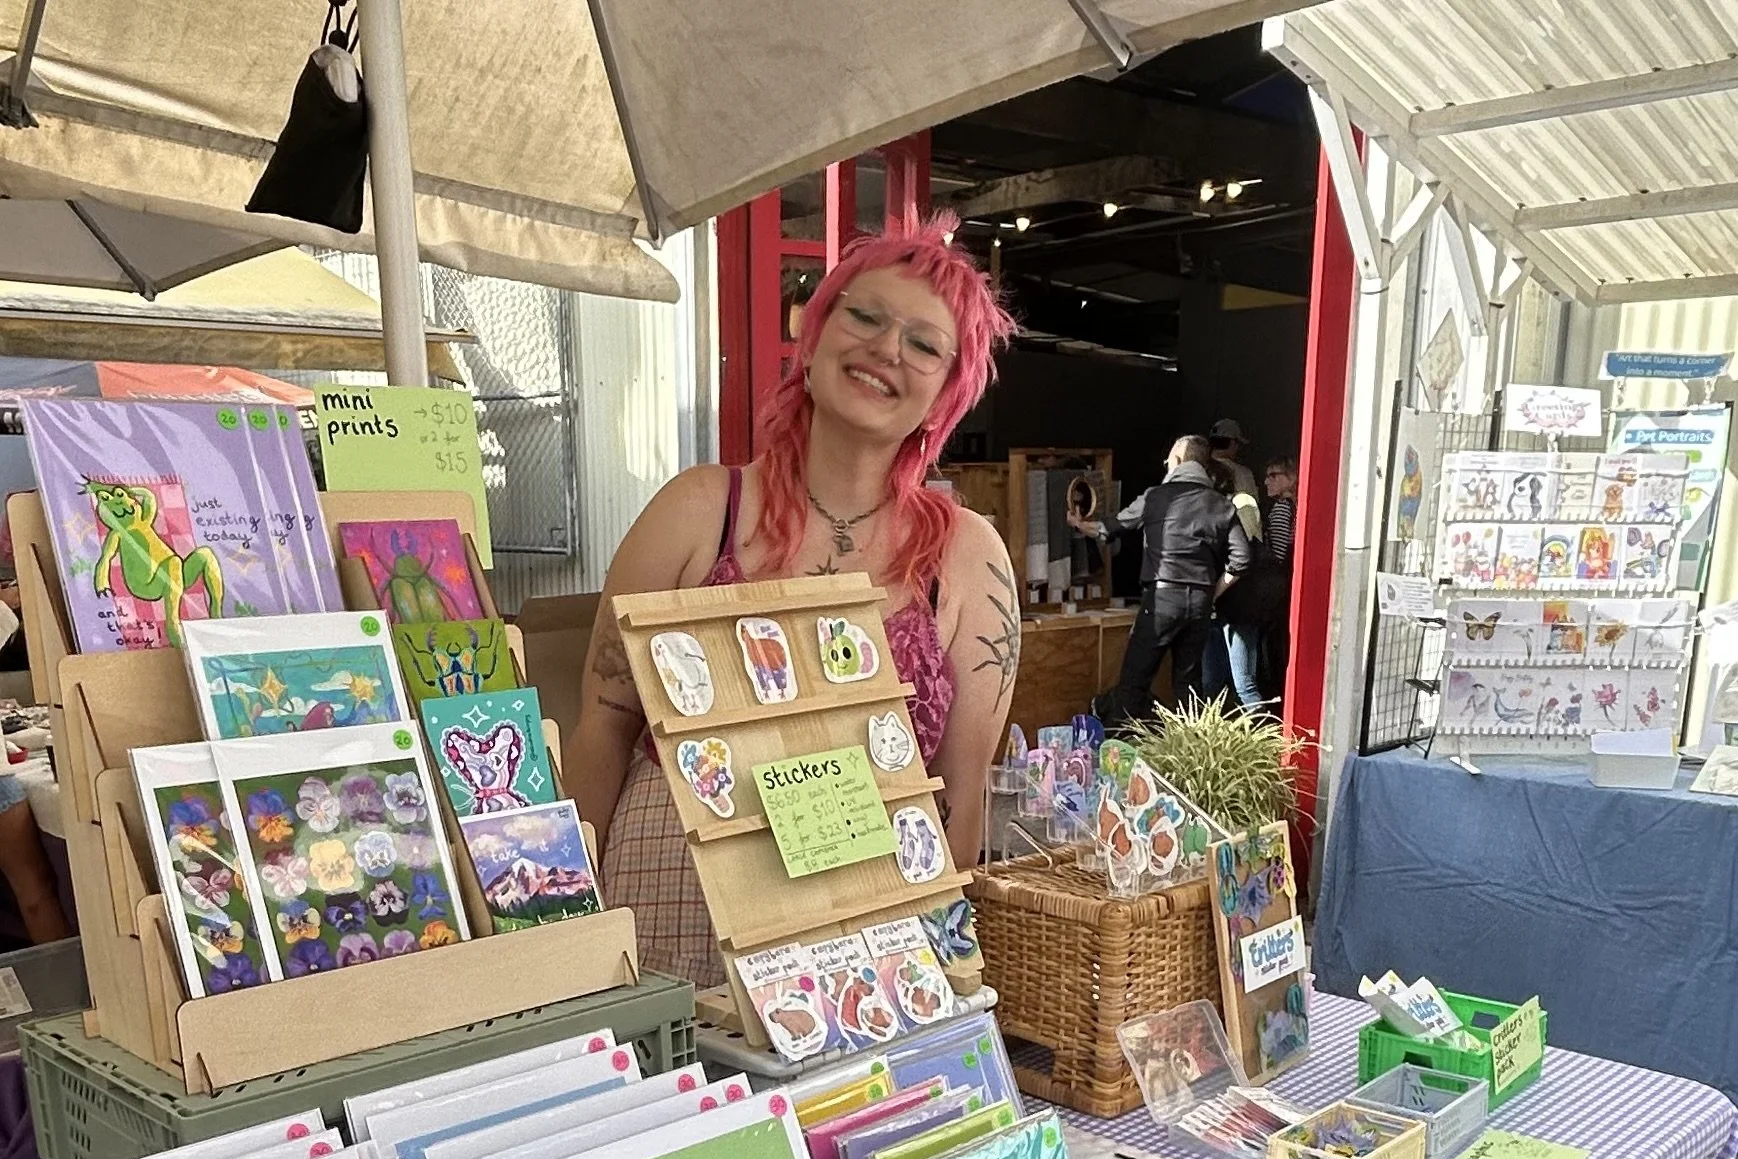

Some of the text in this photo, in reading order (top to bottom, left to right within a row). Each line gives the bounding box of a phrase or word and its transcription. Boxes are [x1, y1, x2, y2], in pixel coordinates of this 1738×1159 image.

[322, 388, 373, 411] mini
[221, 414, 237, 425] 20
[431, 402, 467, 426] $10
[327, 415, 398, 445] prints
[1658, 431, 1713, 442] Portraits
[434, 451, 468, 474] $15
[192, 498, 222, 514] just
[196, 511, 261, 534] existing
[203, 529, 253, 550] today
